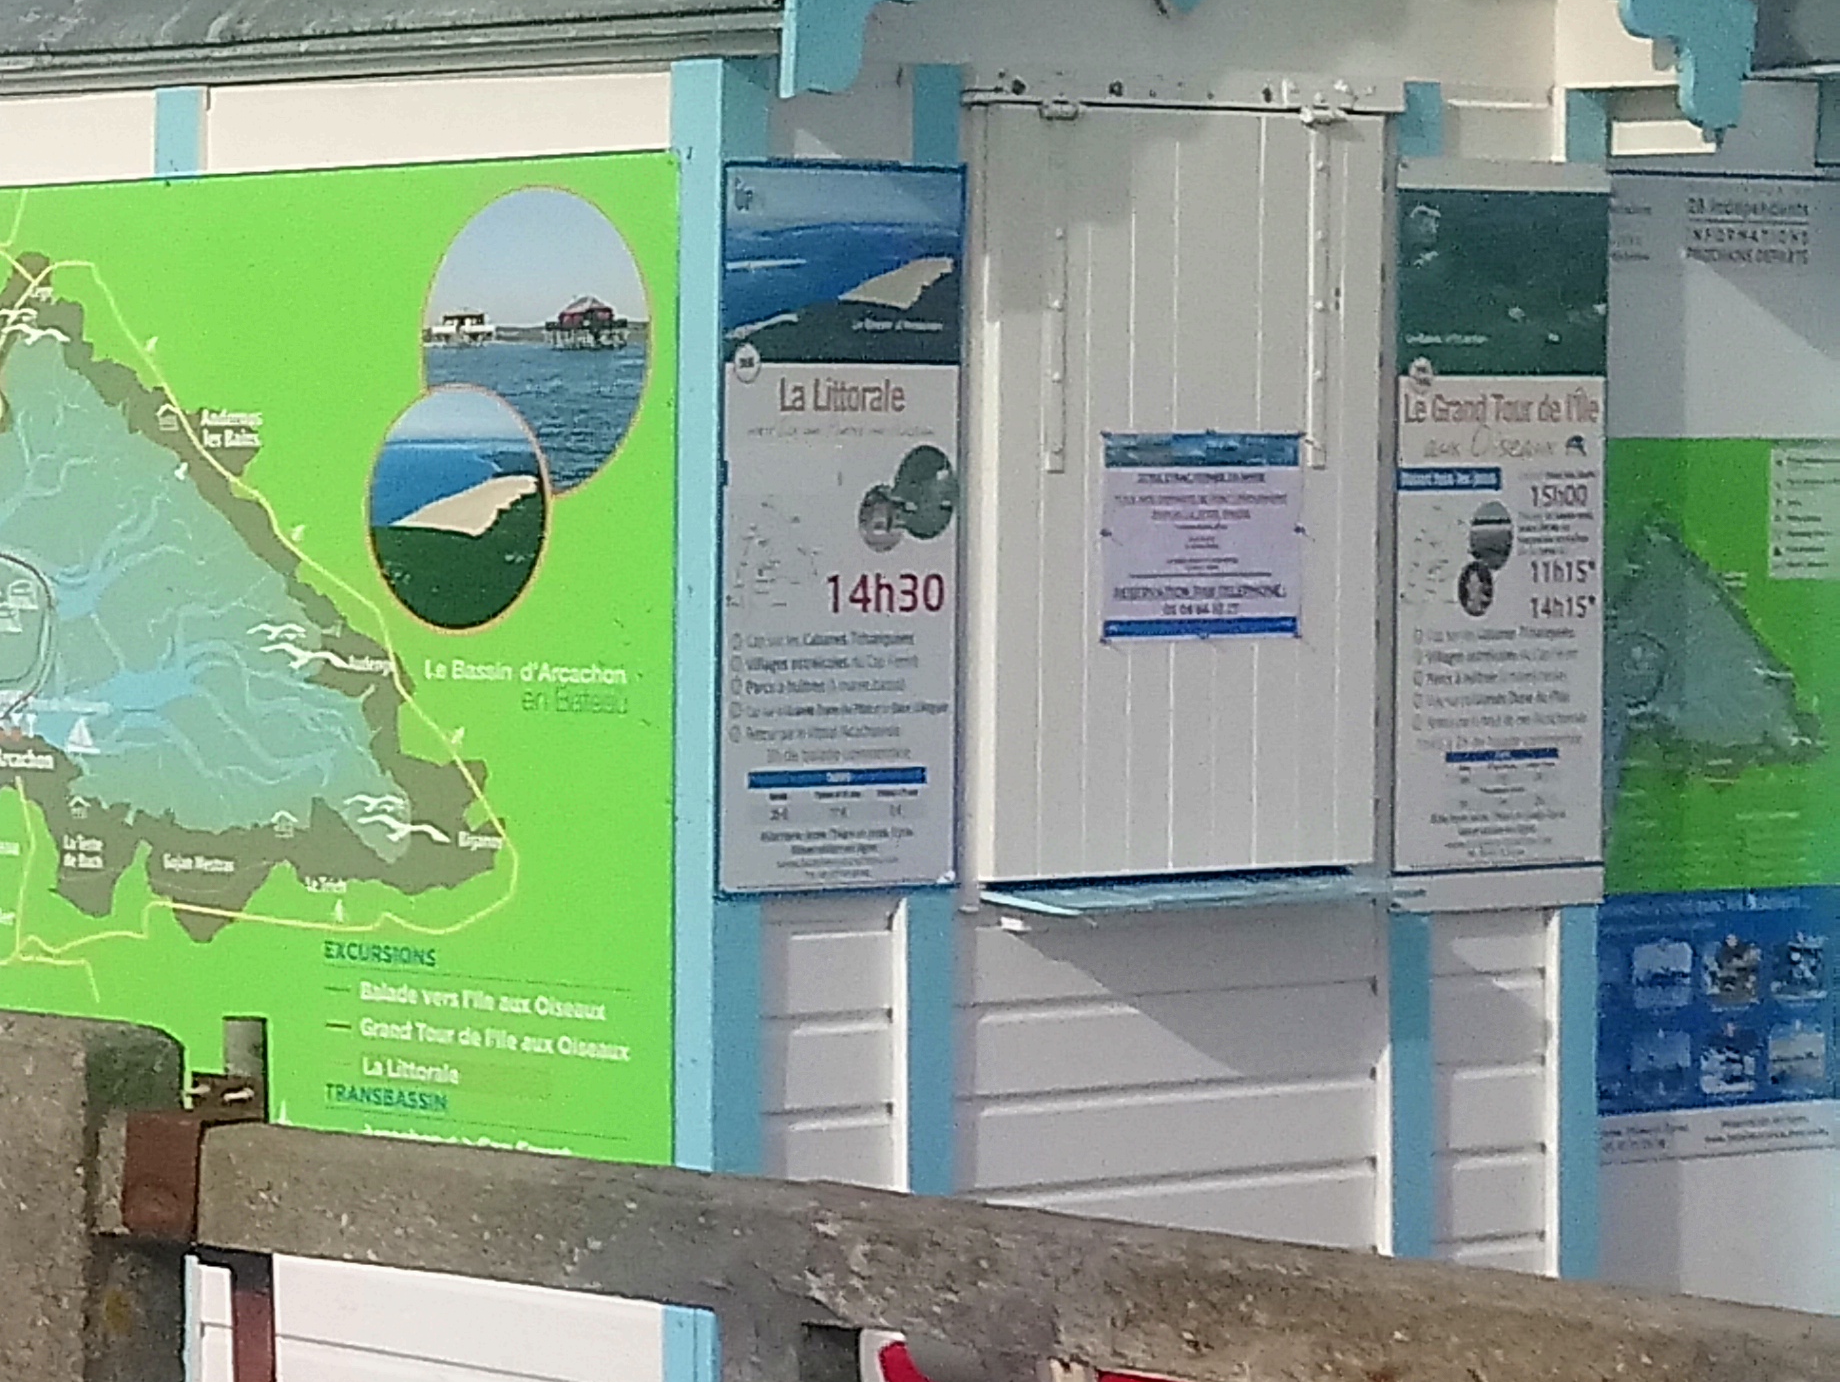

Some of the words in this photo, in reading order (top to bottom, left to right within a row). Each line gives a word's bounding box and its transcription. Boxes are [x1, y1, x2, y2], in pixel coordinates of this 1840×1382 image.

[779, 376, 806, 412] La
[812, 377, 906, 413] Littorale
[1403, 392, 1428, 424] Le
[1431, 392, 1488, 425] Grand
[1490, 392, 1534, 424] Tour
[1537, 392, 1562, 424] de
[202, 428, 222, 448] les
[1530, 484, 1589, 508] 15h00
[826, 572, 946, 614] 14h30
[423, 660, 448, 681] Le
[451, 660, 513, 682] Bassin
[519, 662, 627, 685] d'Arcachon
[323, 939, 437, 967] EXCURSIONS
[359, 980, 418, 1005] Balade
[422, 988, 460, 1009] vers
[499, 998, 533, 1015] aux
[534, 995, 607, 1021] Oiseaux
[359, 1017, 414, 1041] Grand
[415, 1022, 455, 1045] Tour
[458, 1027, 482, 1048] de
[520, 1036, 554, 1055] aux
[556, 1034, 631, 1062] Oiseaux
[362, 1056, 384, 1076] La
[386, 1057, 460, 1085] Littorale
[324, 1082, 448, 1111] TRANSBASSIN
